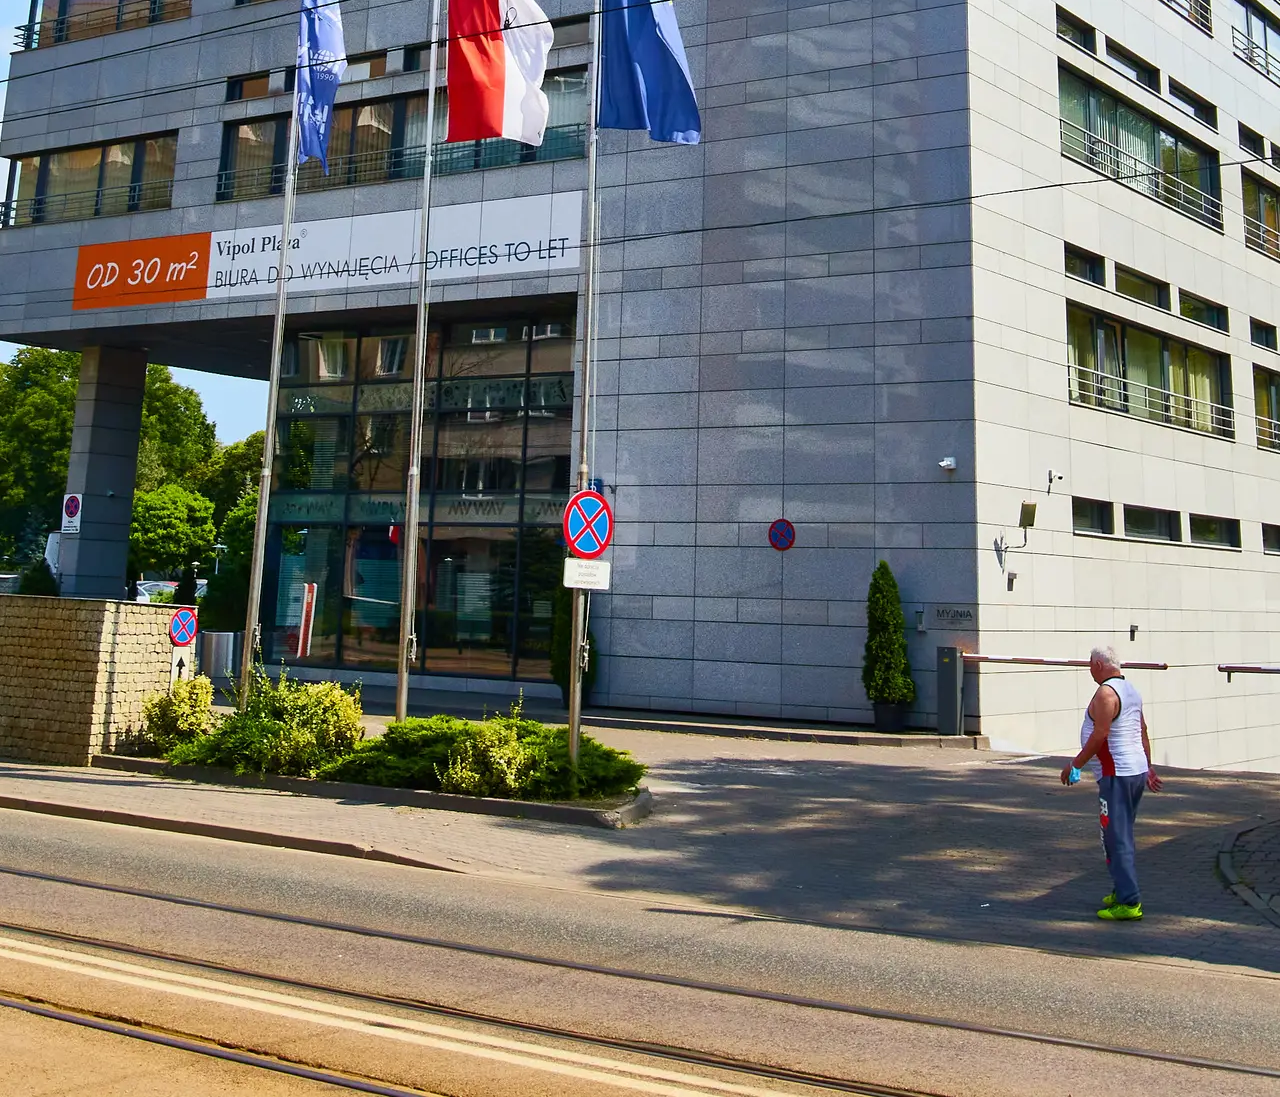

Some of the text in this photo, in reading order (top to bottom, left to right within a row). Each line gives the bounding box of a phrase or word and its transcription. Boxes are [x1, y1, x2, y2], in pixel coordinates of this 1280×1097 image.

[316, 72, 335, 82] 1990
[216, 237, 256, 261] Vipol
[86, 262, 119, 289] OD
[127, 257, 161, 285] 30
[215, 268, 259, 288] BIURA
[301, 255, 400, 280] WYNAJĘCIA
[425, 244, 499, 270] OFFICES
[504, 241, 531, 263] TO
[538, 237, 570, 260] LET
[936, 609, 973, 619] MYJNIA
